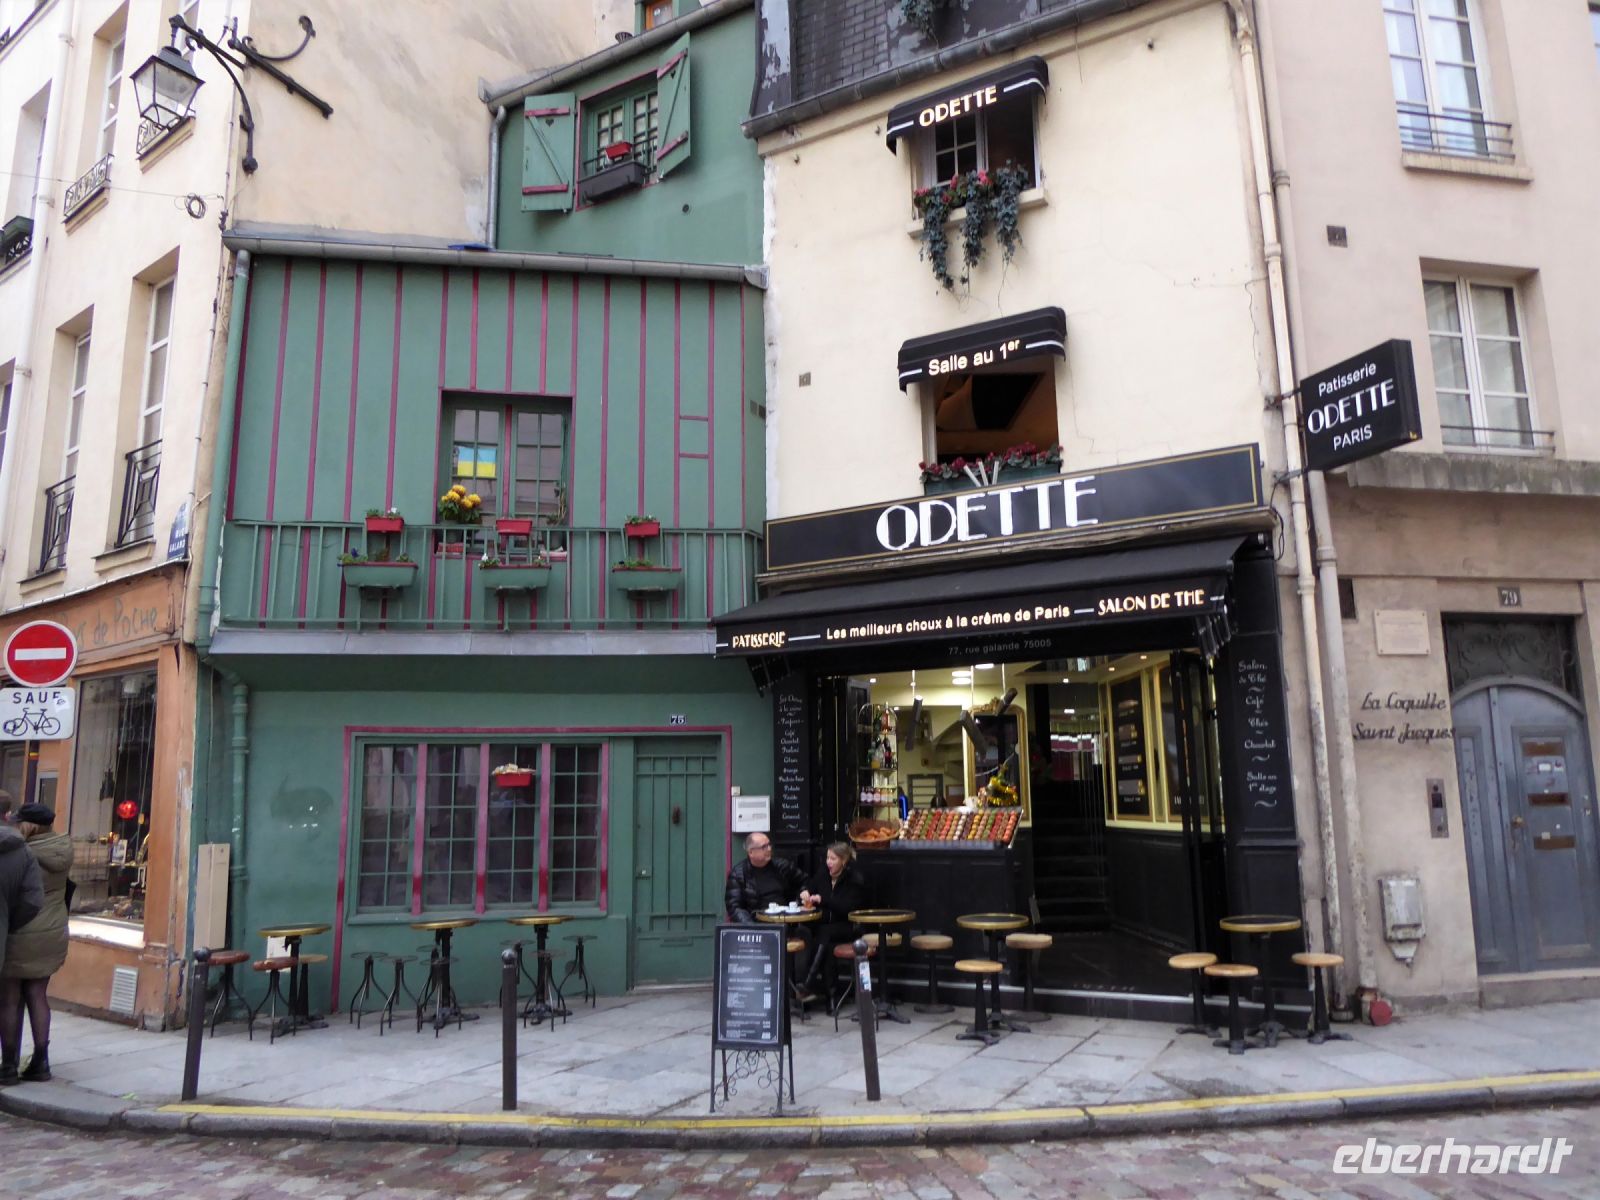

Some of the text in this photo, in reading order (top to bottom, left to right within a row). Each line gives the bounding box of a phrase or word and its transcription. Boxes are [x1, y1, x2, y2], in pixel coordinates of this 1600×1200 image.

[919, 84, 997, 127] ODETTE
[928, 338, 1021, 376] Salle au 1er
[1318, 362, 1377, 397] Patisserie
[1307, 378, 1396, 434] ODETTE
[1333, 424, 1373, 451] PARIS
[876, 475, 1099, 551] ODETTE
[1097, 595, 1148, 616] SALON
[1150, 592, 1171, 609] DE
[1501, 590, 1518, 605] 79
[826, 627, 847, 640] Les
[849, 623, 903, 638] meilleurs
[905, 619, 942, 632] choux
[956, 615, 968, 627] la
[1014, 608, 1031, 622] de
[1034, 604, 1070, 620] Paris
[732, 631, 786, 649] PATISSERIE
[965, 646, 980, 654] rue
[982, 642, 1020, 654] galande
[1023, 638, 1053, 649] 75005
